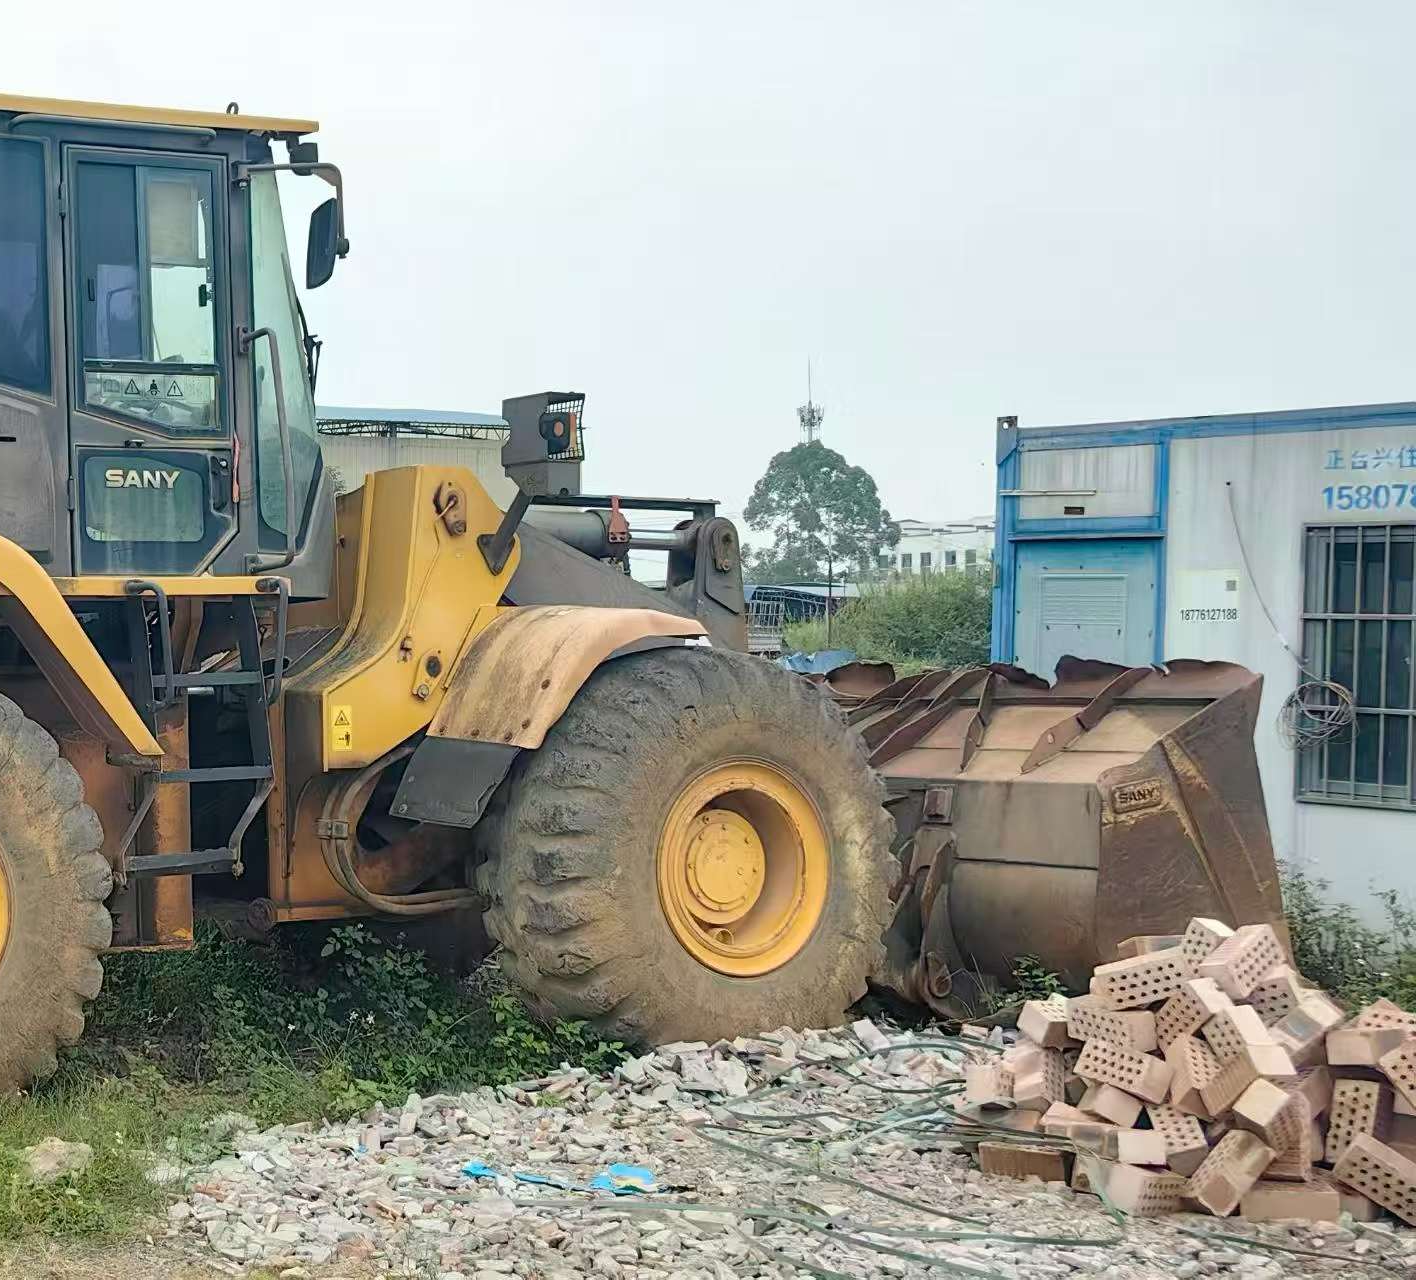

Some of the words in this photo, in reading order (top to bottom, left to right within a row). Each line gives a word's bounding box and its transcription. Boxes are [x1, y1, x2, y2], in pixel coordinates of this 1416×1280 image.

[104, 469, 181, 489] SANY
[1180, 608, 1238, 621] 18776127188
[1119, 787, 1155, 804] SANY
